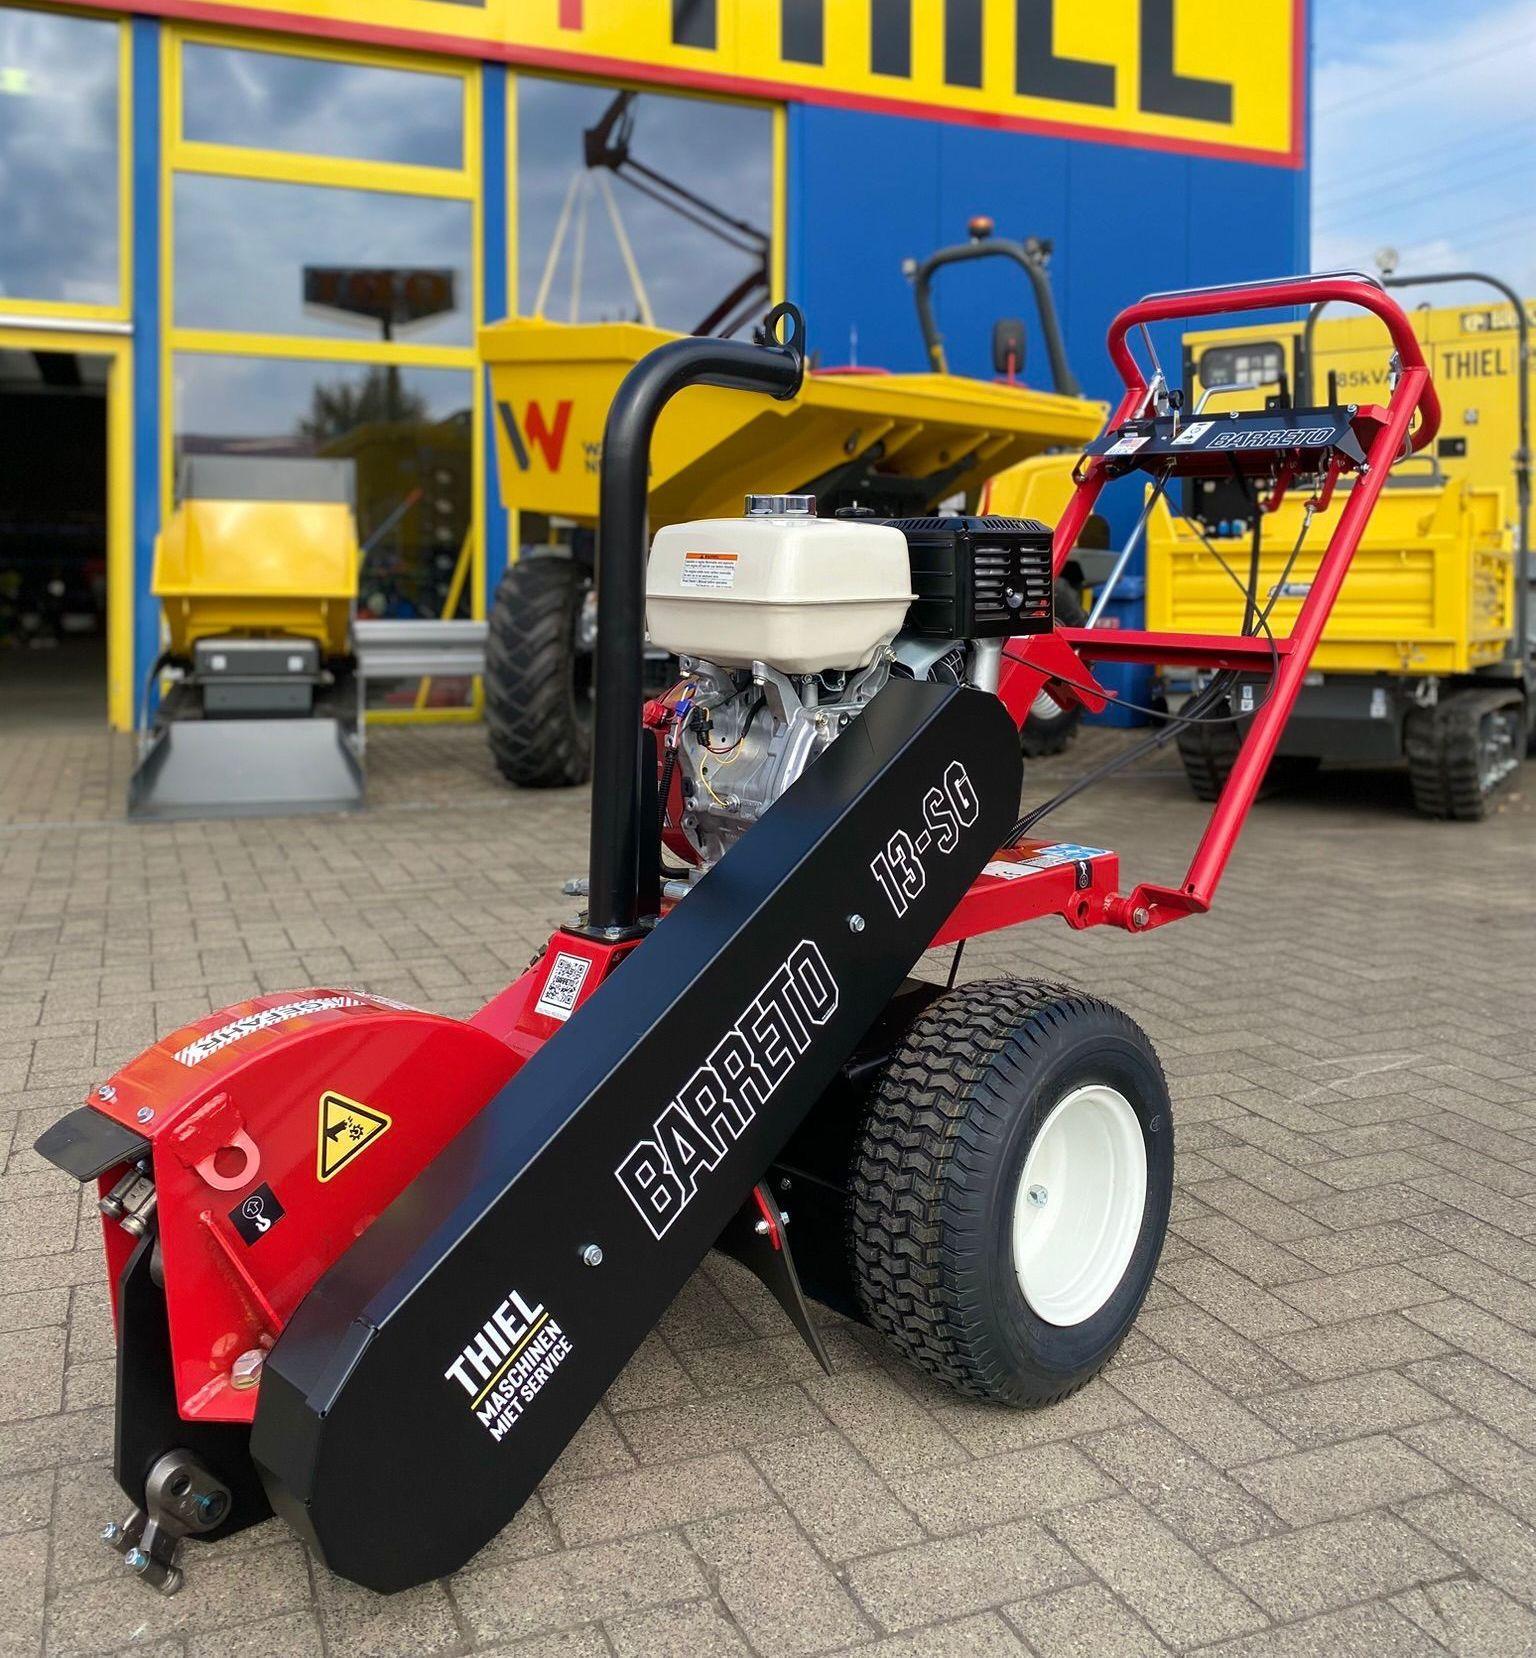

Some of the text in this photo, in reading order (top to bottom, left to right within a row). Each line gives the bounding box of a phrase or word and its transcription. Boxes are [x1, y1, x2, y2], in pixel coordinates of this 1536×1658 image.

[1442, 347, 1507, 380] THIEL
[1205, 427, 1336, 449] BARRETO
[870, 760, 980, 919] 13-SG
[196, 1001, 325, 1051] GEFAHR
[614, 939, 840, 1241] BARRETO
[444, 1289, 545, 1397] THIEL
[476, 1319, 563, 1428] MASCHINEN
[489, 1335, 574, 1442] MIET SERVICE
